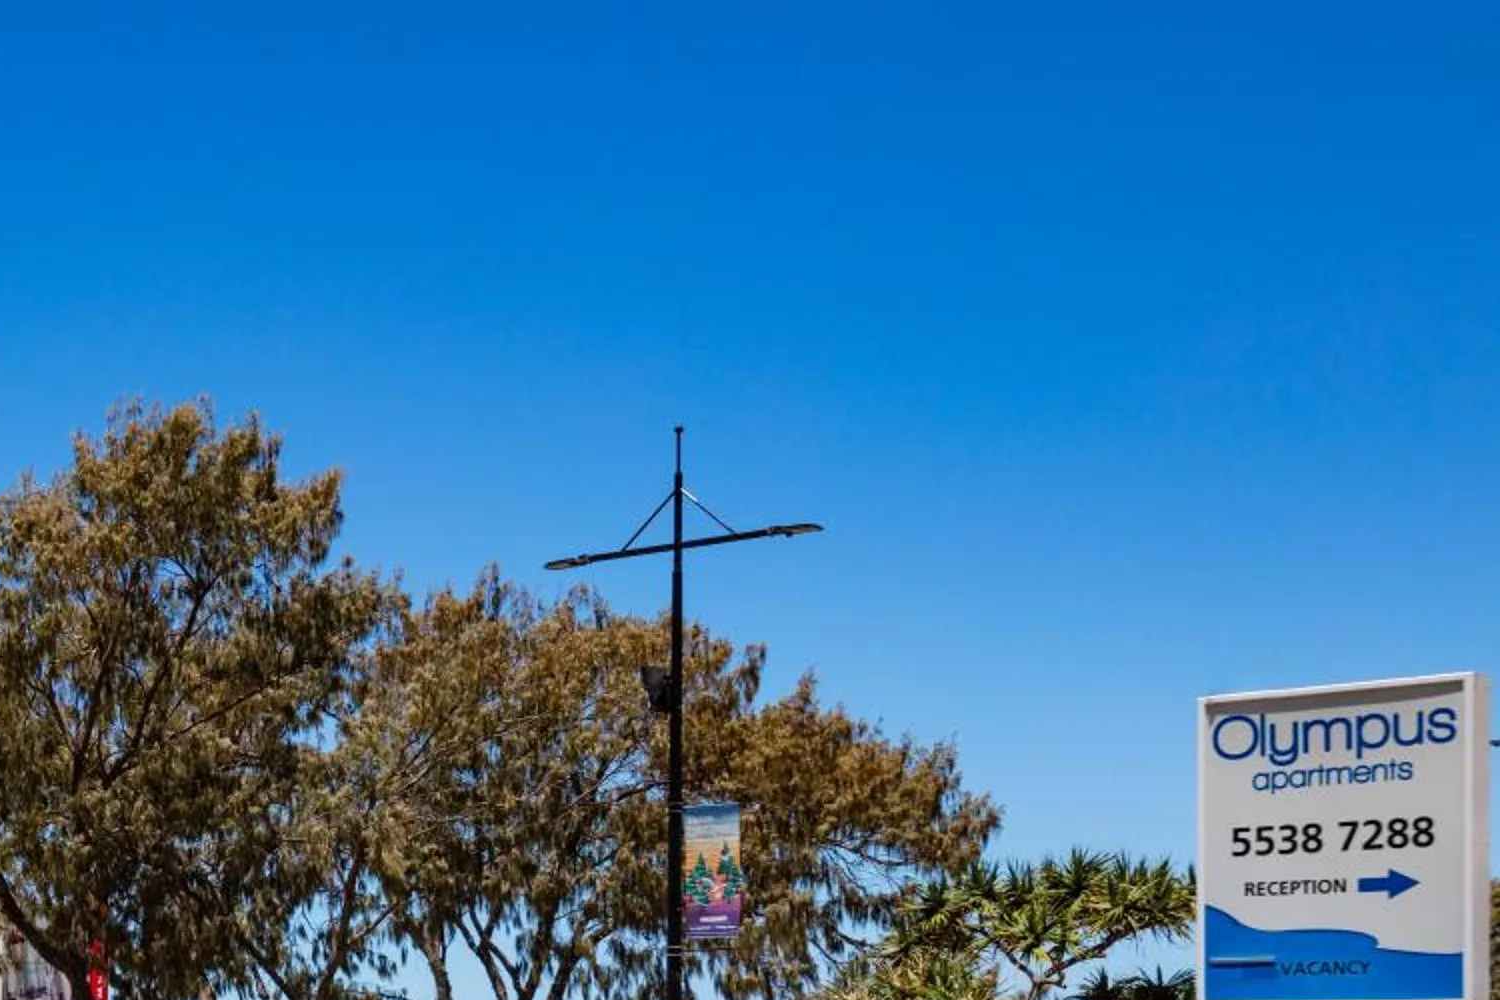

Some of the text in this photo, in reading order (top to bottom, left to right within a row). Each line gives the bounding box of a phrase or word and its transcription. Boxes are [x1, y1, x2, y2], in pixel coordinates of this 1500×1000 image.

[1212, 707, 1458, 766] Olympus
[1252, 759, 1414, 794] apartments
[1231, 816, 1435, 857] 5538 7288
[1243, 878, 1348, 897] RECEPTION
[1280, 960, 1372, 977] VACANCY
